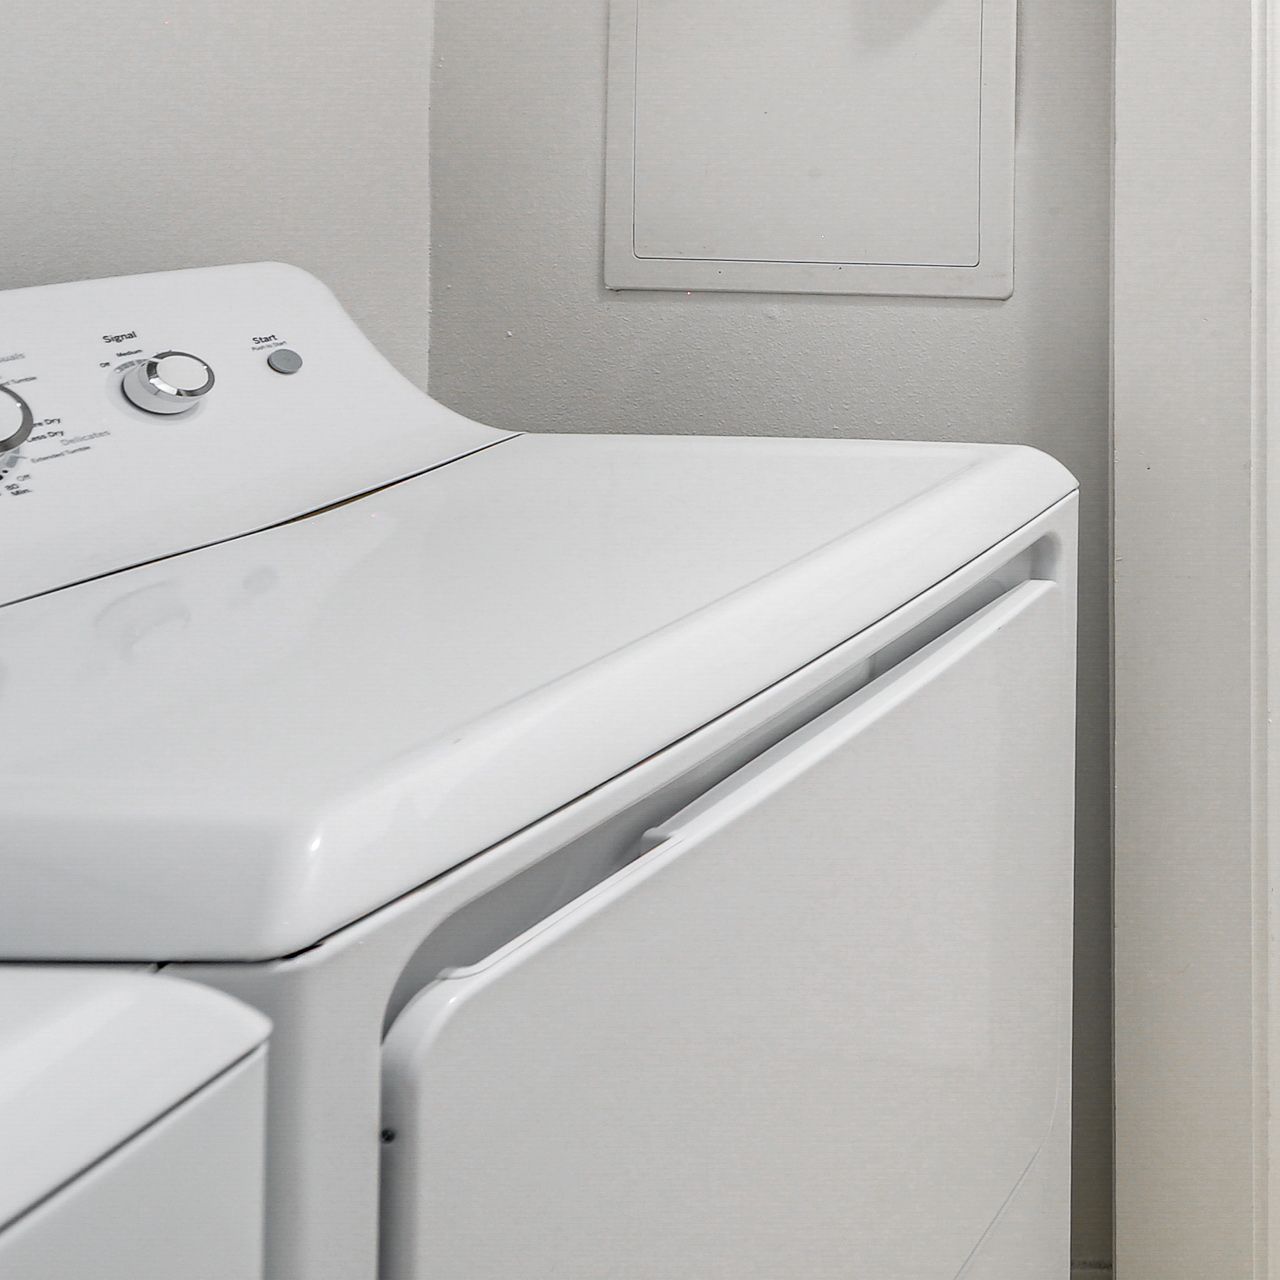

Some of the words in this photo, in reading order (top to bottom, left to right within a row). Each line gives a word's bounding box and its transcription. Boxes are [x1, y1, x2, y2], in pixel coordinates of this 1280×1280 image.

[102, 330, 137, 343] Signal
[252, 334, 278, 344] Start
[47, 430, 64, 438] Dry
